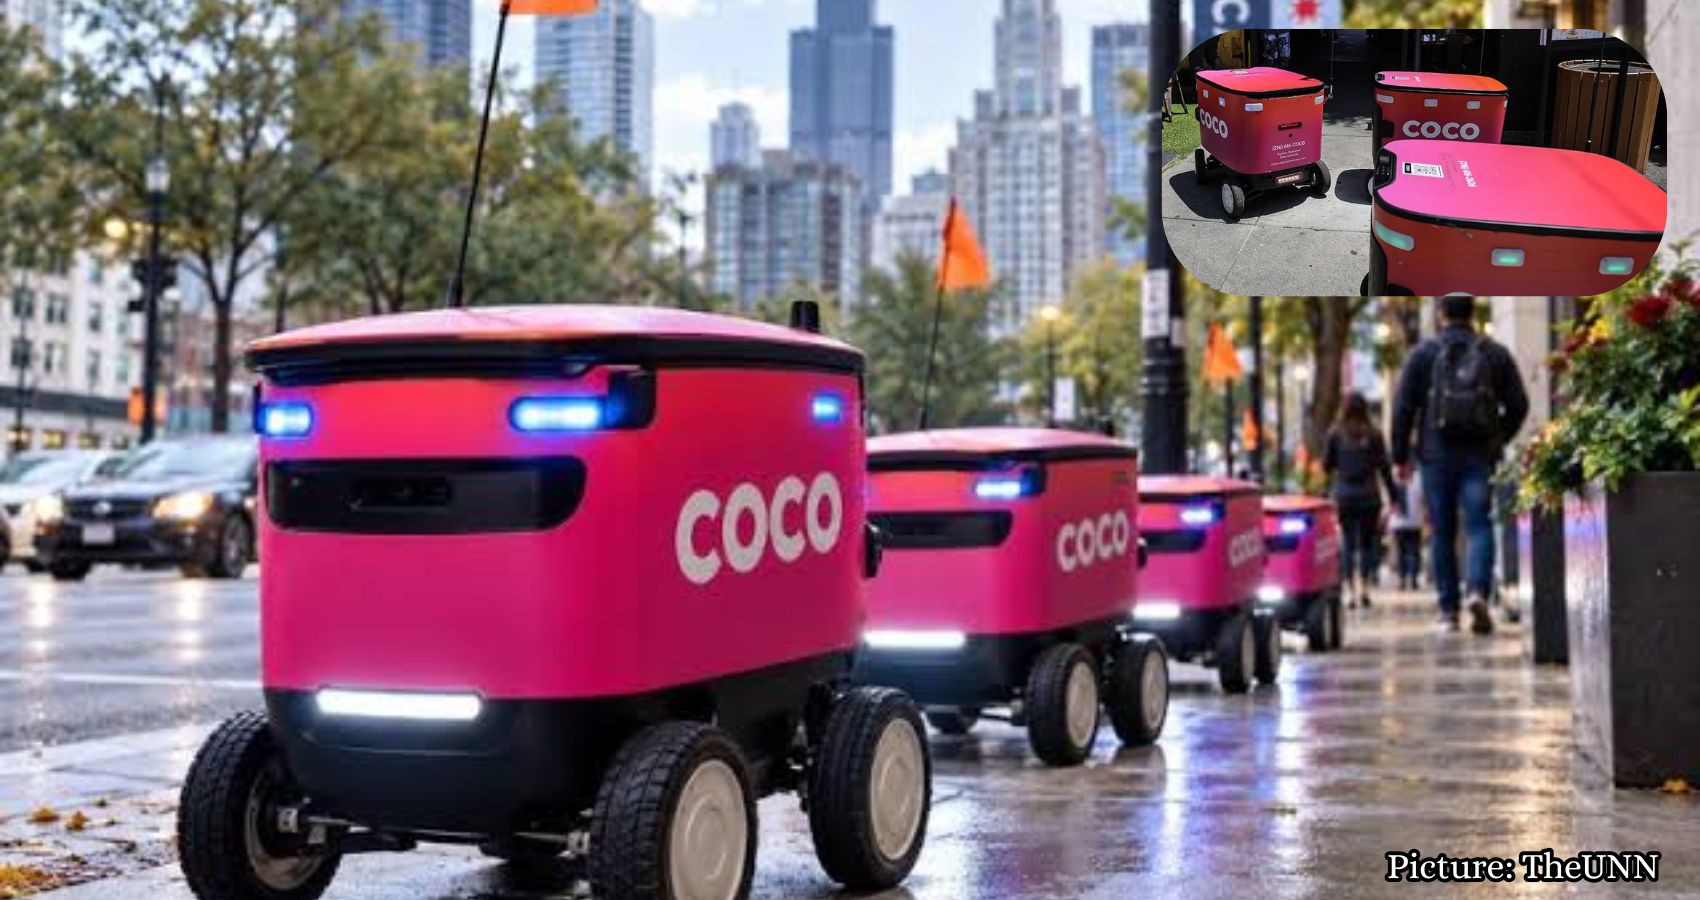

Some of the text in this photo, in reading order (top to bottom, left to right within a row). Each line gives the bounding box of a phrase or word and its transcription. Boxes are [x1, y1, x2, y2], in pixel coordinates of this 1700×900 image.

[1199, 108, 1229, 139] COCO
[1402, 120, 1480, 140] COCO
[675, 471, 843, 585] COCO
[1057, 509, 1129, 573] COCO
